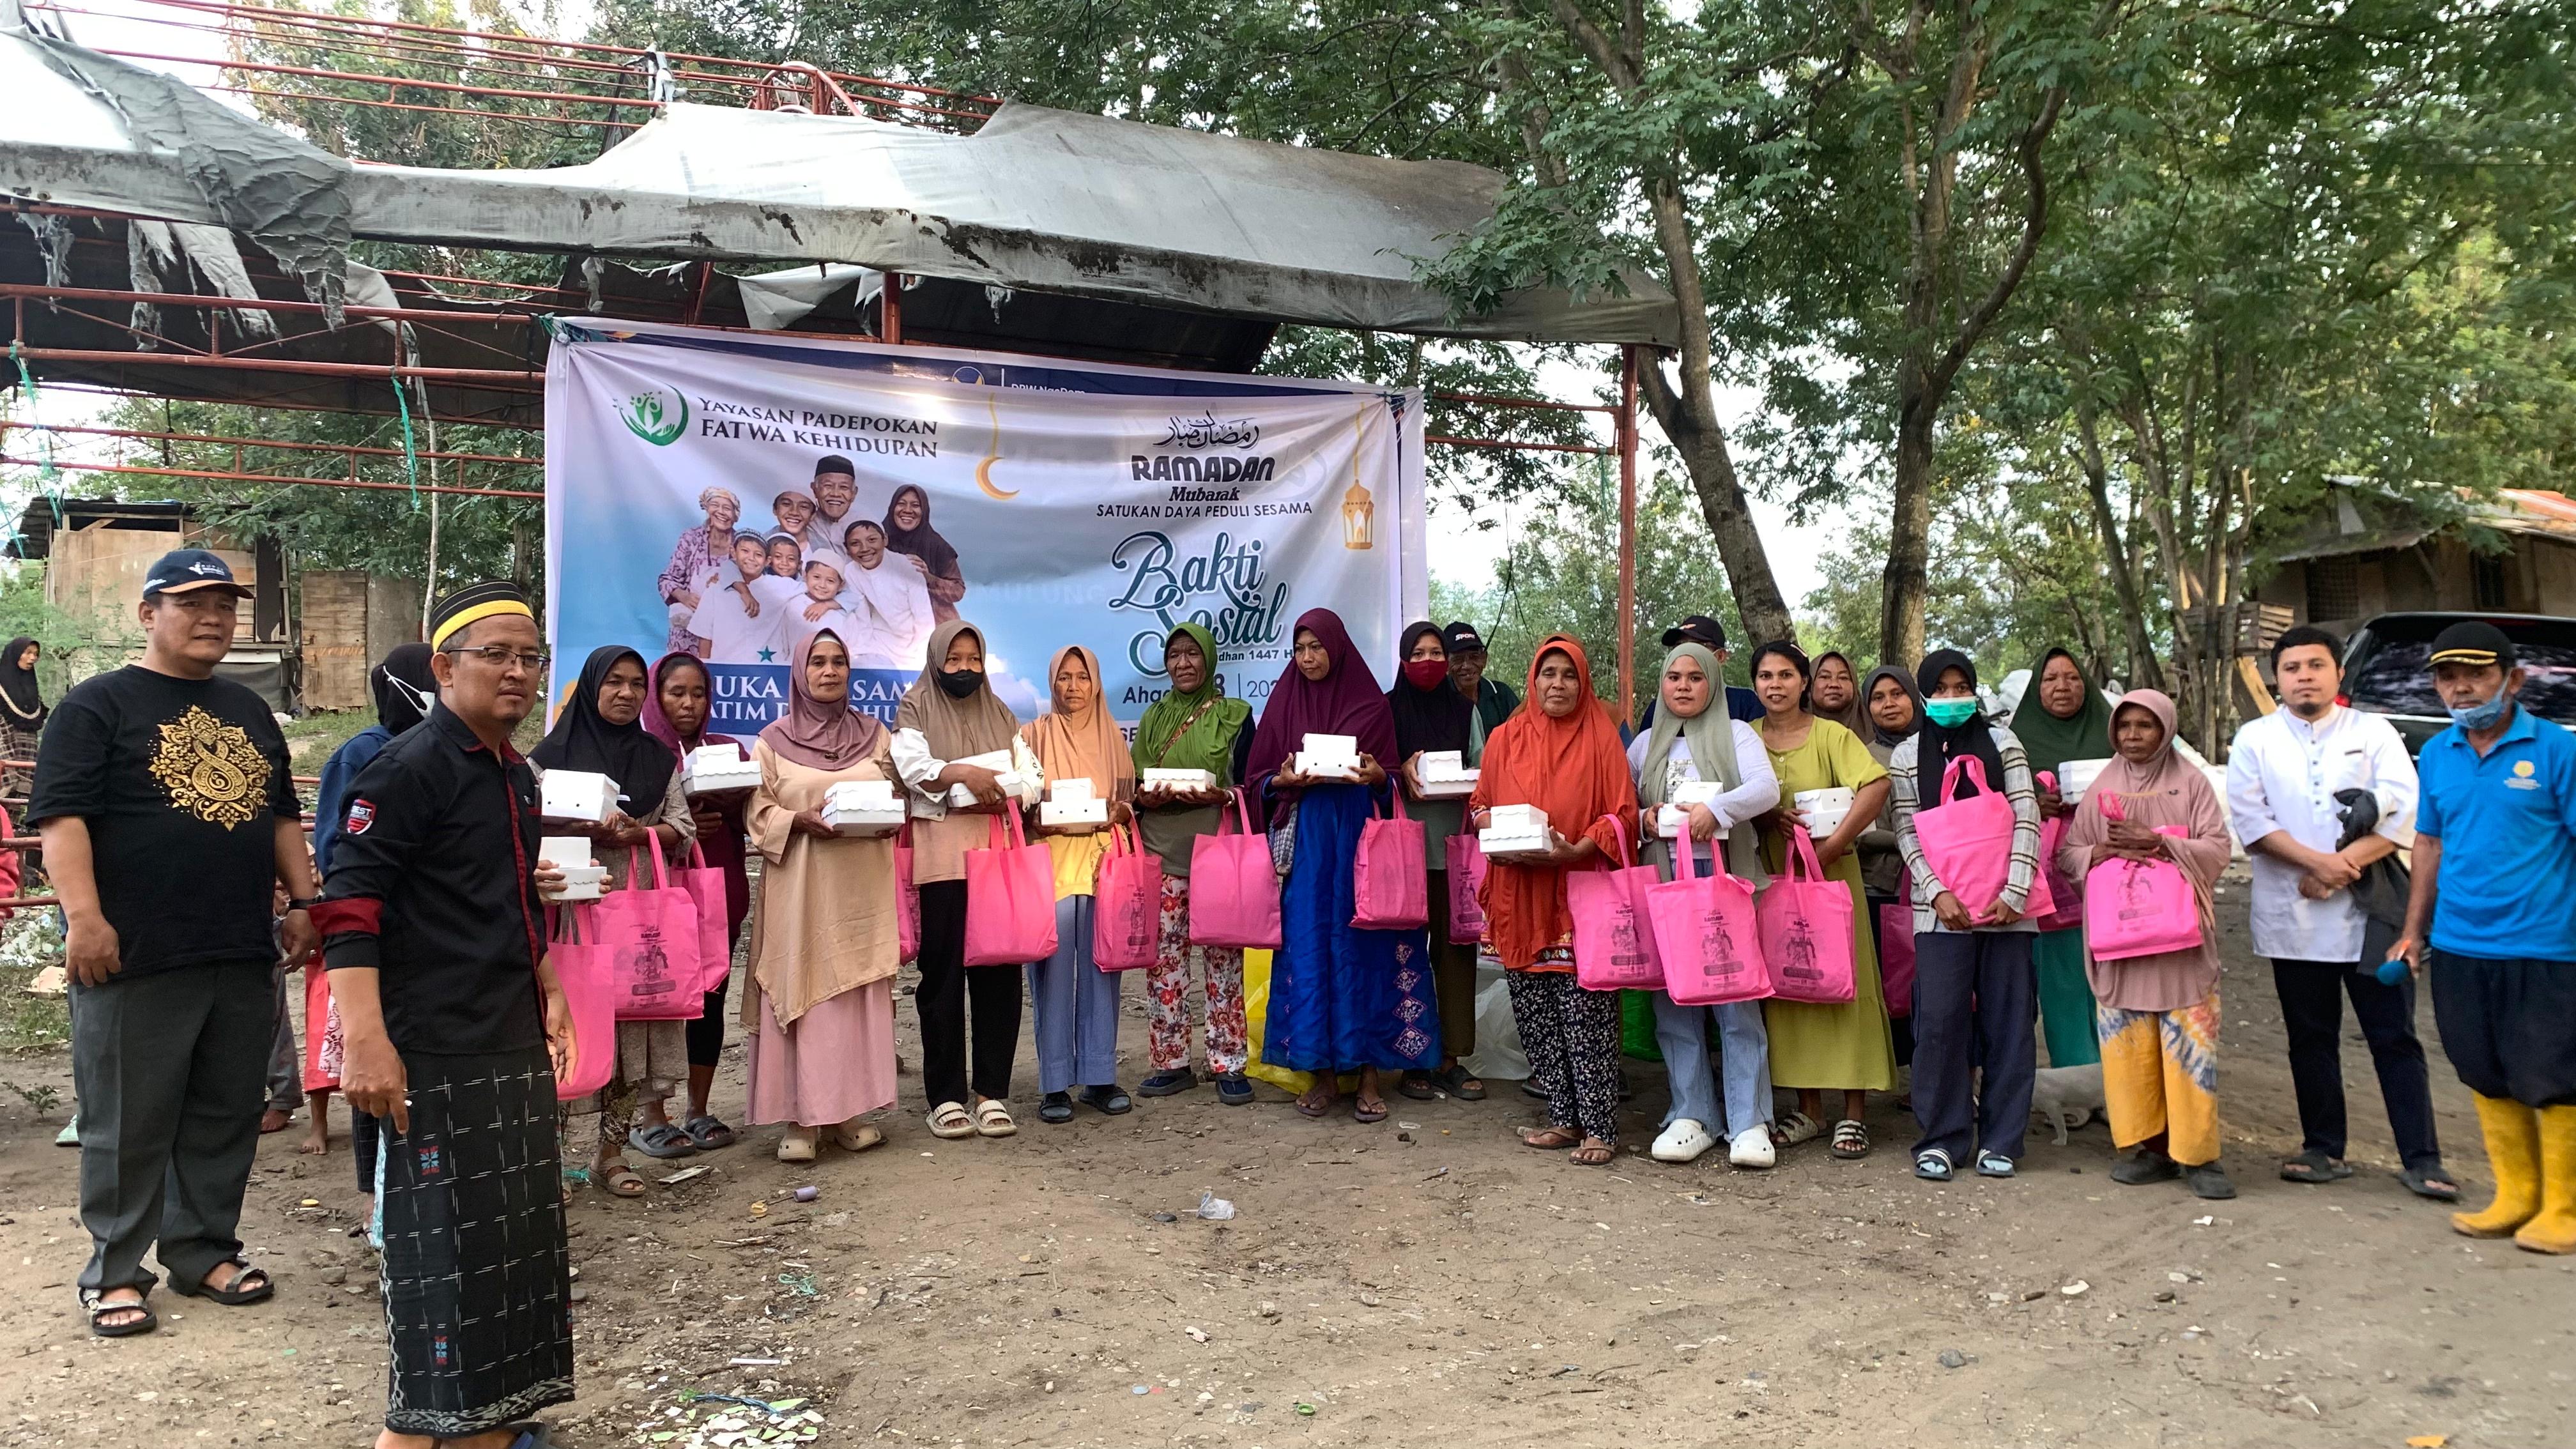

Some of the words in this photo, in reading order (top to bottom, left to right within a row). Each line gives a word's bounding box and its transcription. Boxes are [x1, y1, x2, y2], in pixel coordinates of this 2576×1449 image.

[698, 397, 794, 424] YAYASAN
[802, 411, 938, 435] PADEPOKAN
[702, 419, 786, 443] FATWA
[792, 429, 937, 458] KEHIDUPAN
[1131, 455, 1275, 482] RAMADAN
[1169, 486, 1240, 502] Mubarak
[1096, 504, 1160, 518] SATUKAN
[1165, 506, 1199, 518] DAYA
[1205, 505, 1249, 517] PEDULI
[1254, 502, 1312, 516] SESAMA
[1109, 532, 1264, 608] Bakti
[1455, 633, 1475, 641] SPORT
[1218, 651, 1245, 661] dhan
[1248, 650, 1279, 660] 1447
[1284, 649, 1293, 659] H
[711, 675, 783, 698] UKA
[848, 679, 908, 701] SAM
[848, 705, 900, 723] HU
